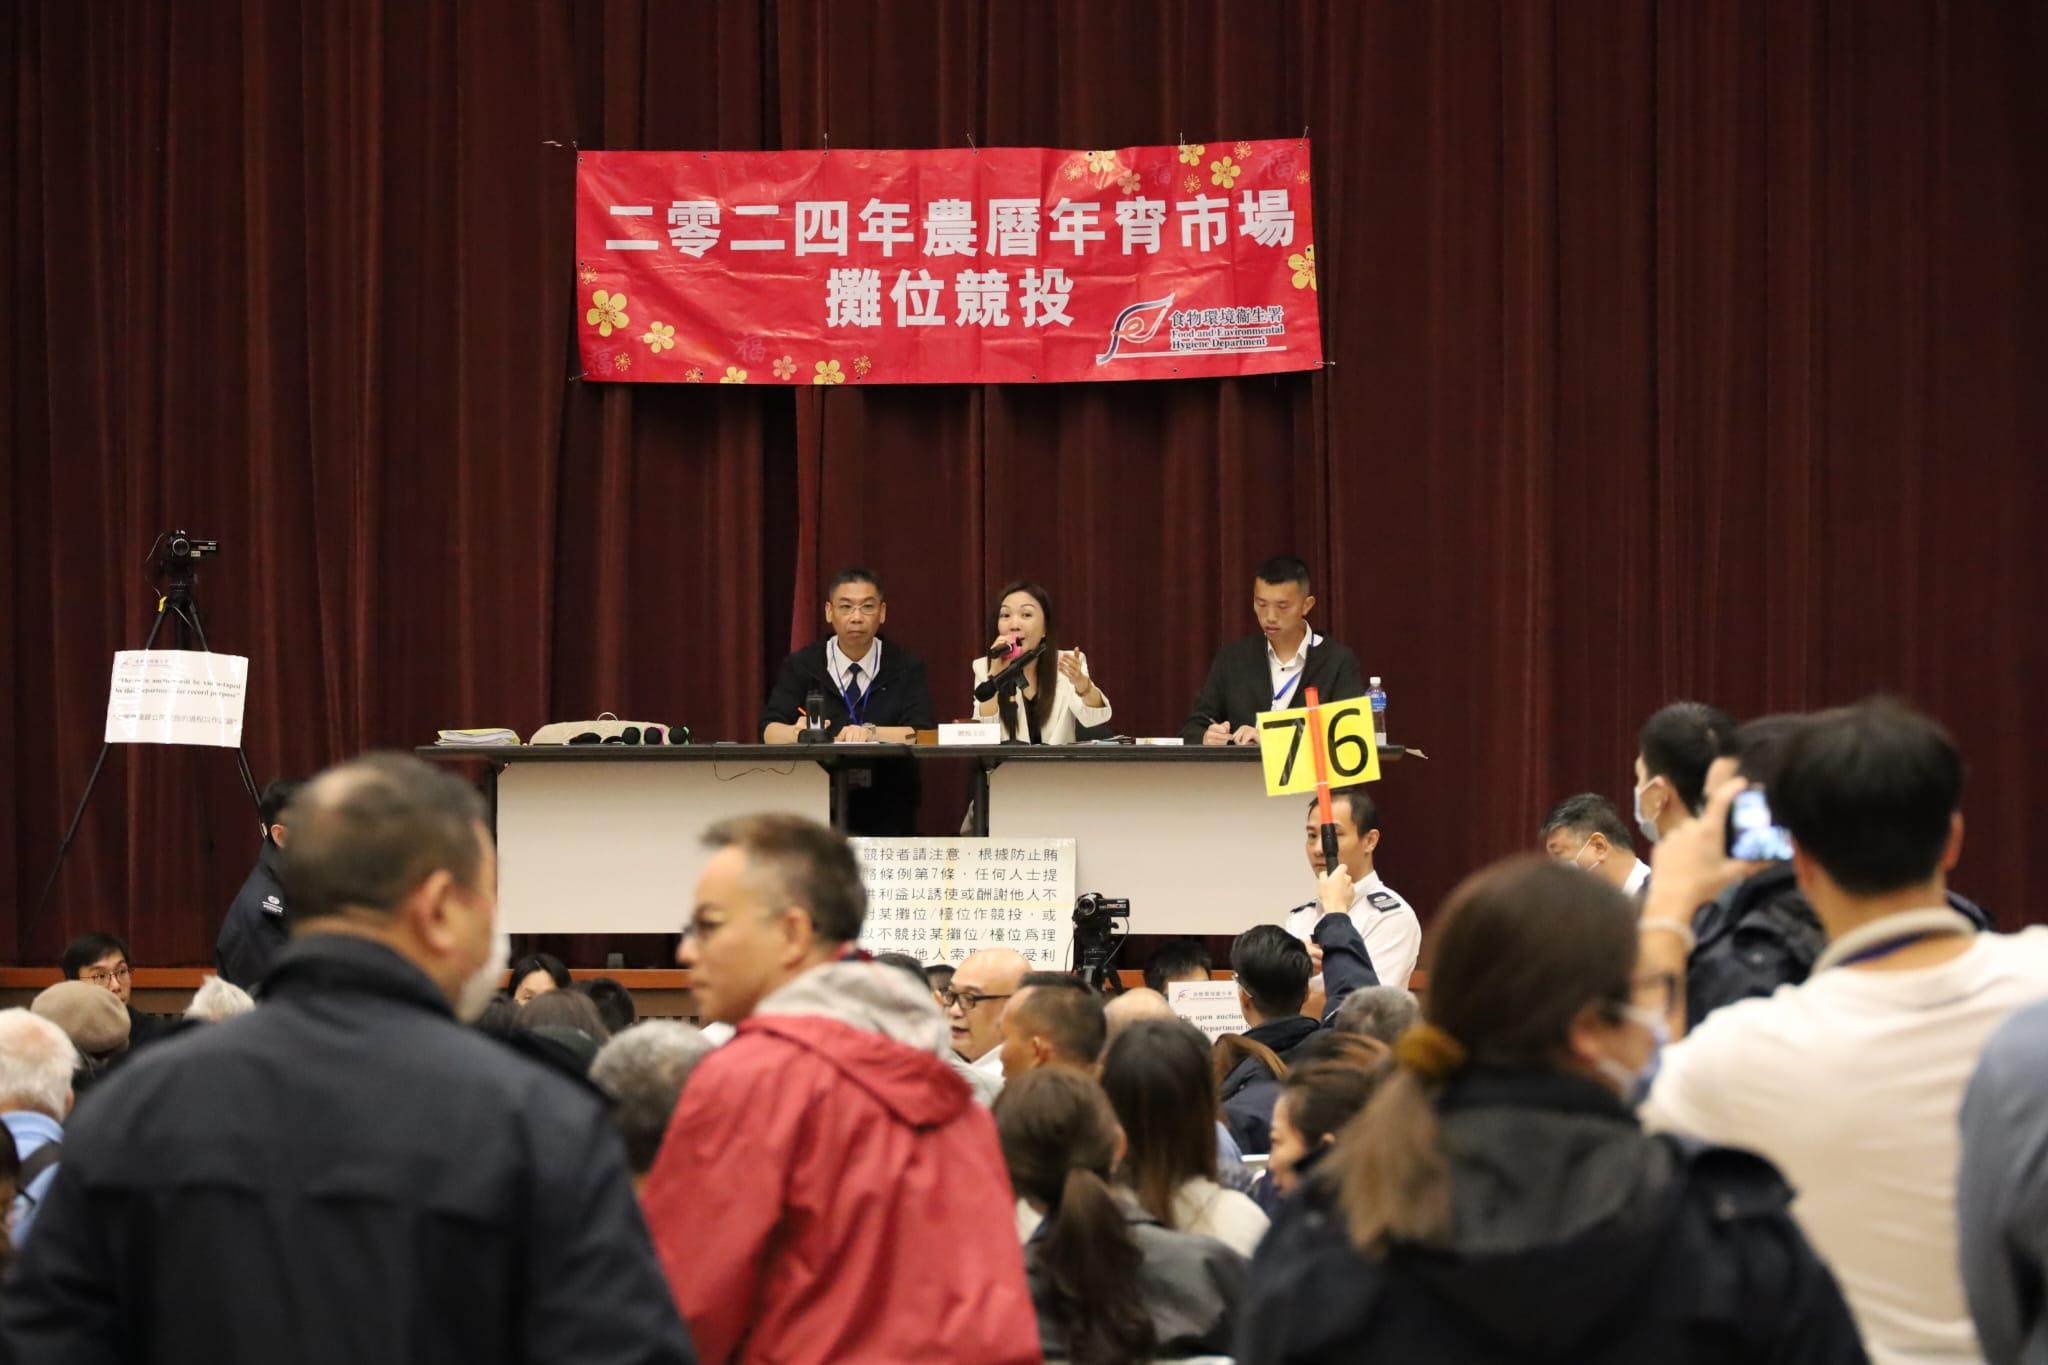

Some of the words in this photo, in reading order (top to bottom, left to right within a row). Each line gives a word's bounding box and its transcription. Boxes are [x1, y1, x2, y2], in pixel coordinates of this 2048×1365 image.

[605, 189, 1295, 258] 二零二四年農曆年宵市場
[825, 267, 1074, 328] 攤位競投
[1172, 329, 1195, 338] Food
[1197, 328, 1214, 337] and
[1216, 325, 1284, 337] Environmental
[1172, 339, 1210, 350] Hygiene
[1212, 337, 1266, 348] Department
[1263, 708, 1368, 786] 76
[1195, 1014, 1213, 1022] open
[1200, 1024, 1243, 1032] Department
